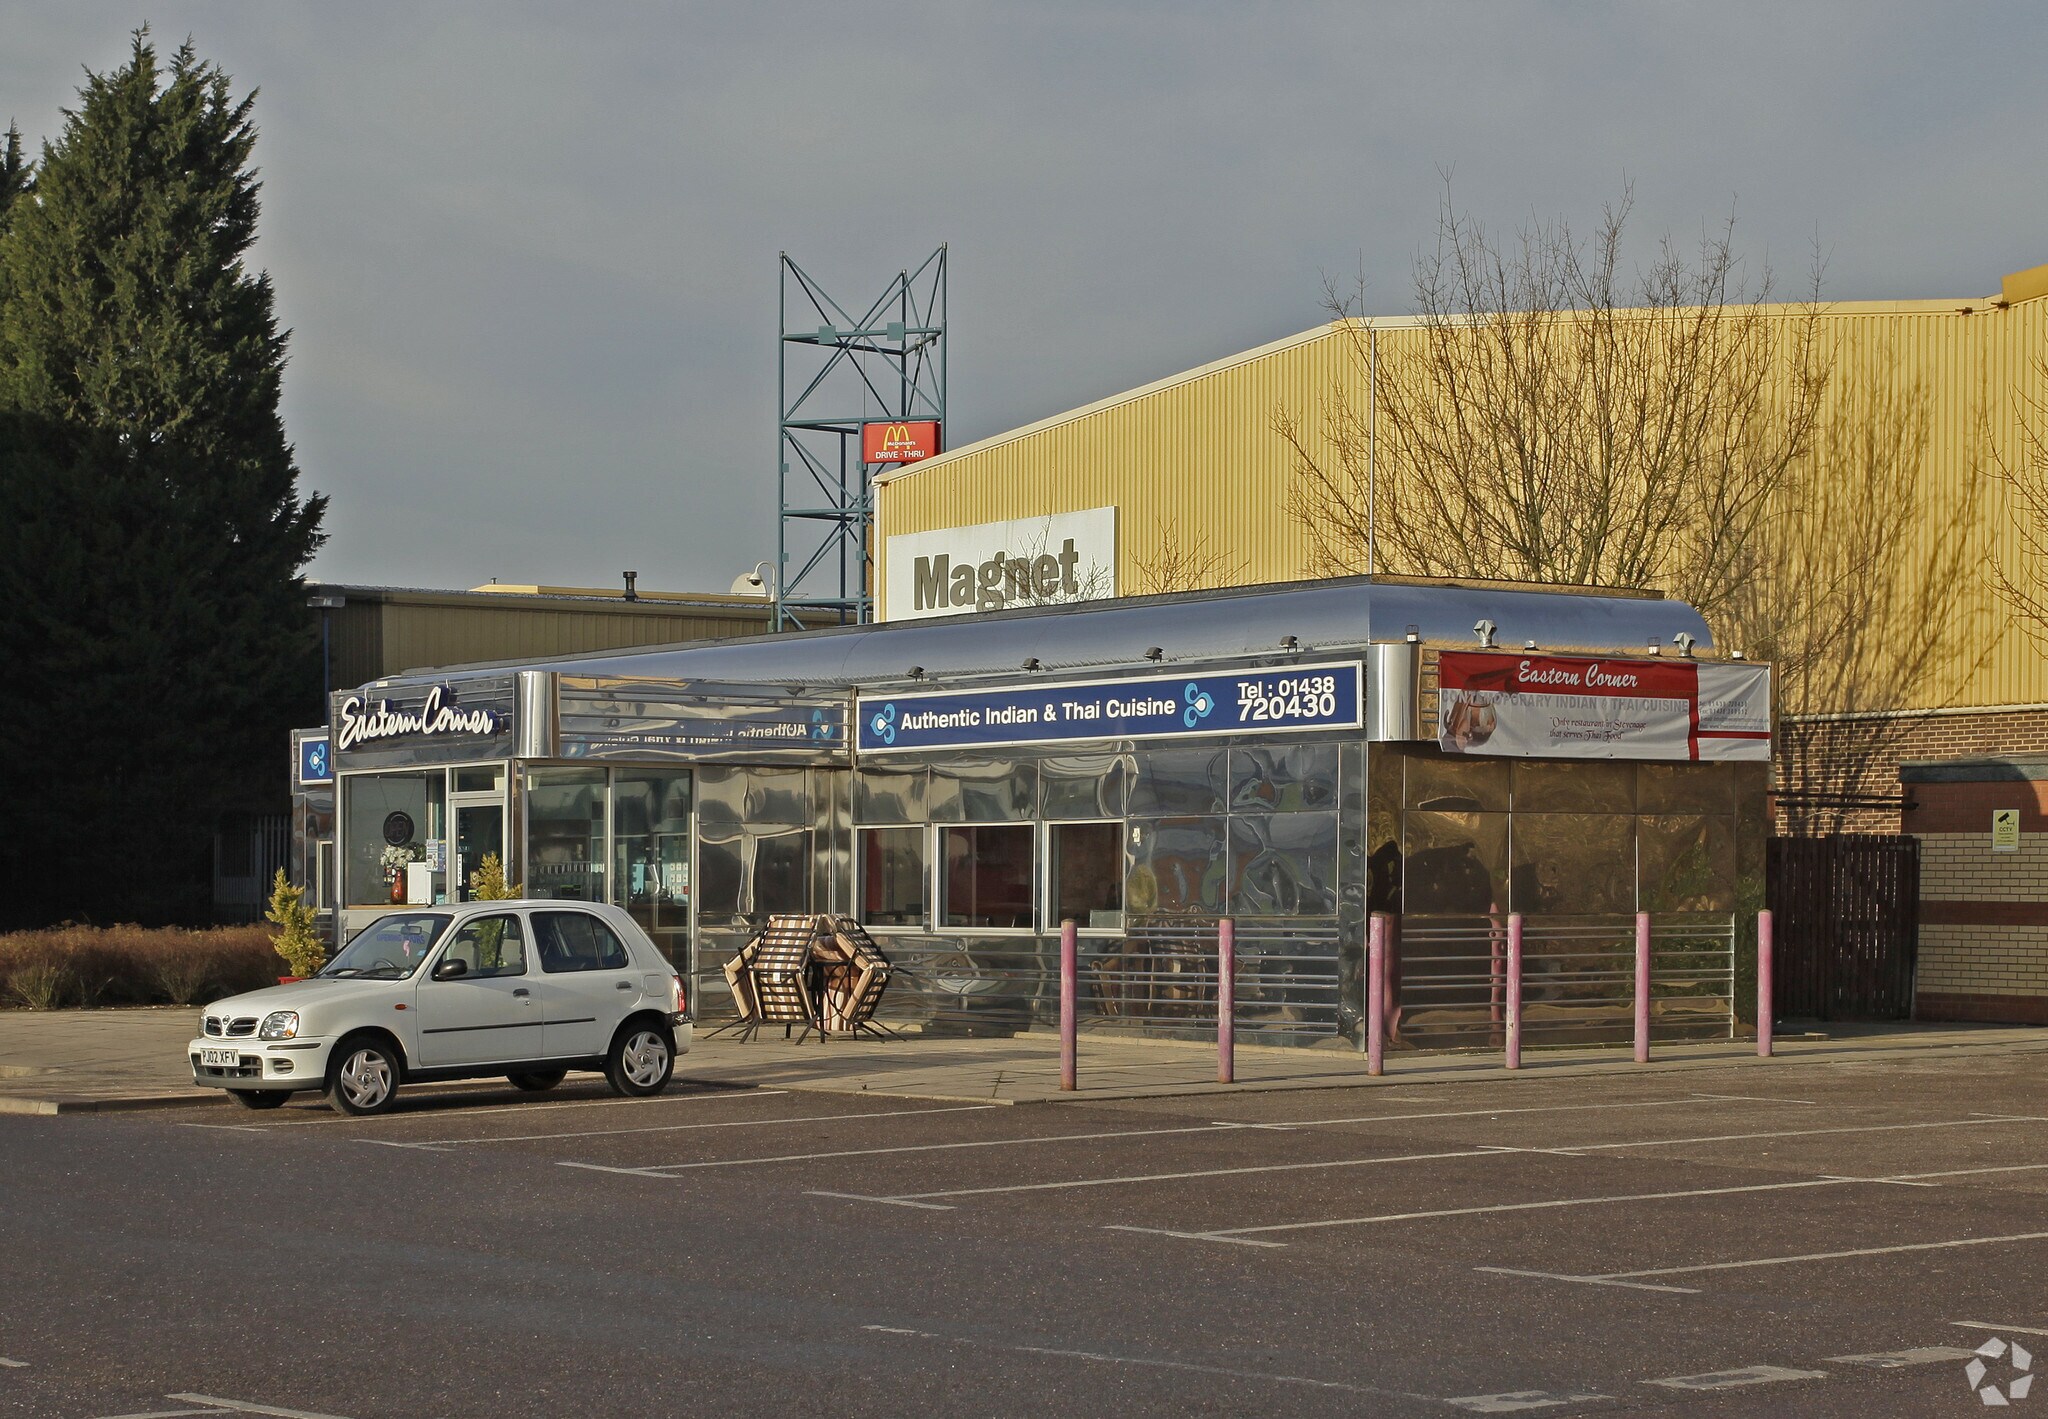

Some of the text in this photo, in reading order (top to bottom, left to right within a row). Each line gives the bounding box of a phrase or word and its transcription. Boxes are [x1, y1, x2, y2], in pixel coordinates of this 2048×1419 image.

[875, 451, 899, 459] DRIVE
[903, 450, 925, 458] THRU
[914, 538, 1079, 612] Magnet
[1519, 661, 1638, 688] Eastern Corner
[1237, 681, 1263, 700] Tel
[1278, 676, 1335, 697] 01438
[900, 696, 1176, 731] Authentic Indian & Thai Cuisine
[1237, 693, 1336, 722] 720430
[1556, 696, 1597, 709] INDIAN
[1612, 698, 1641, 711] THAI
[1644, 699, 1689, 713] CUISINE
[339, 685, 494, 750] Eastern Corner
[1571, 719, 1604, 729] restaurant
[1549, 729, 1563, 738] that
[1563, 730, 1583, 739] serves
[1583, 730, 1602, 740] Thai
[202, 1050, 235, 1063] PJ02 XFV
